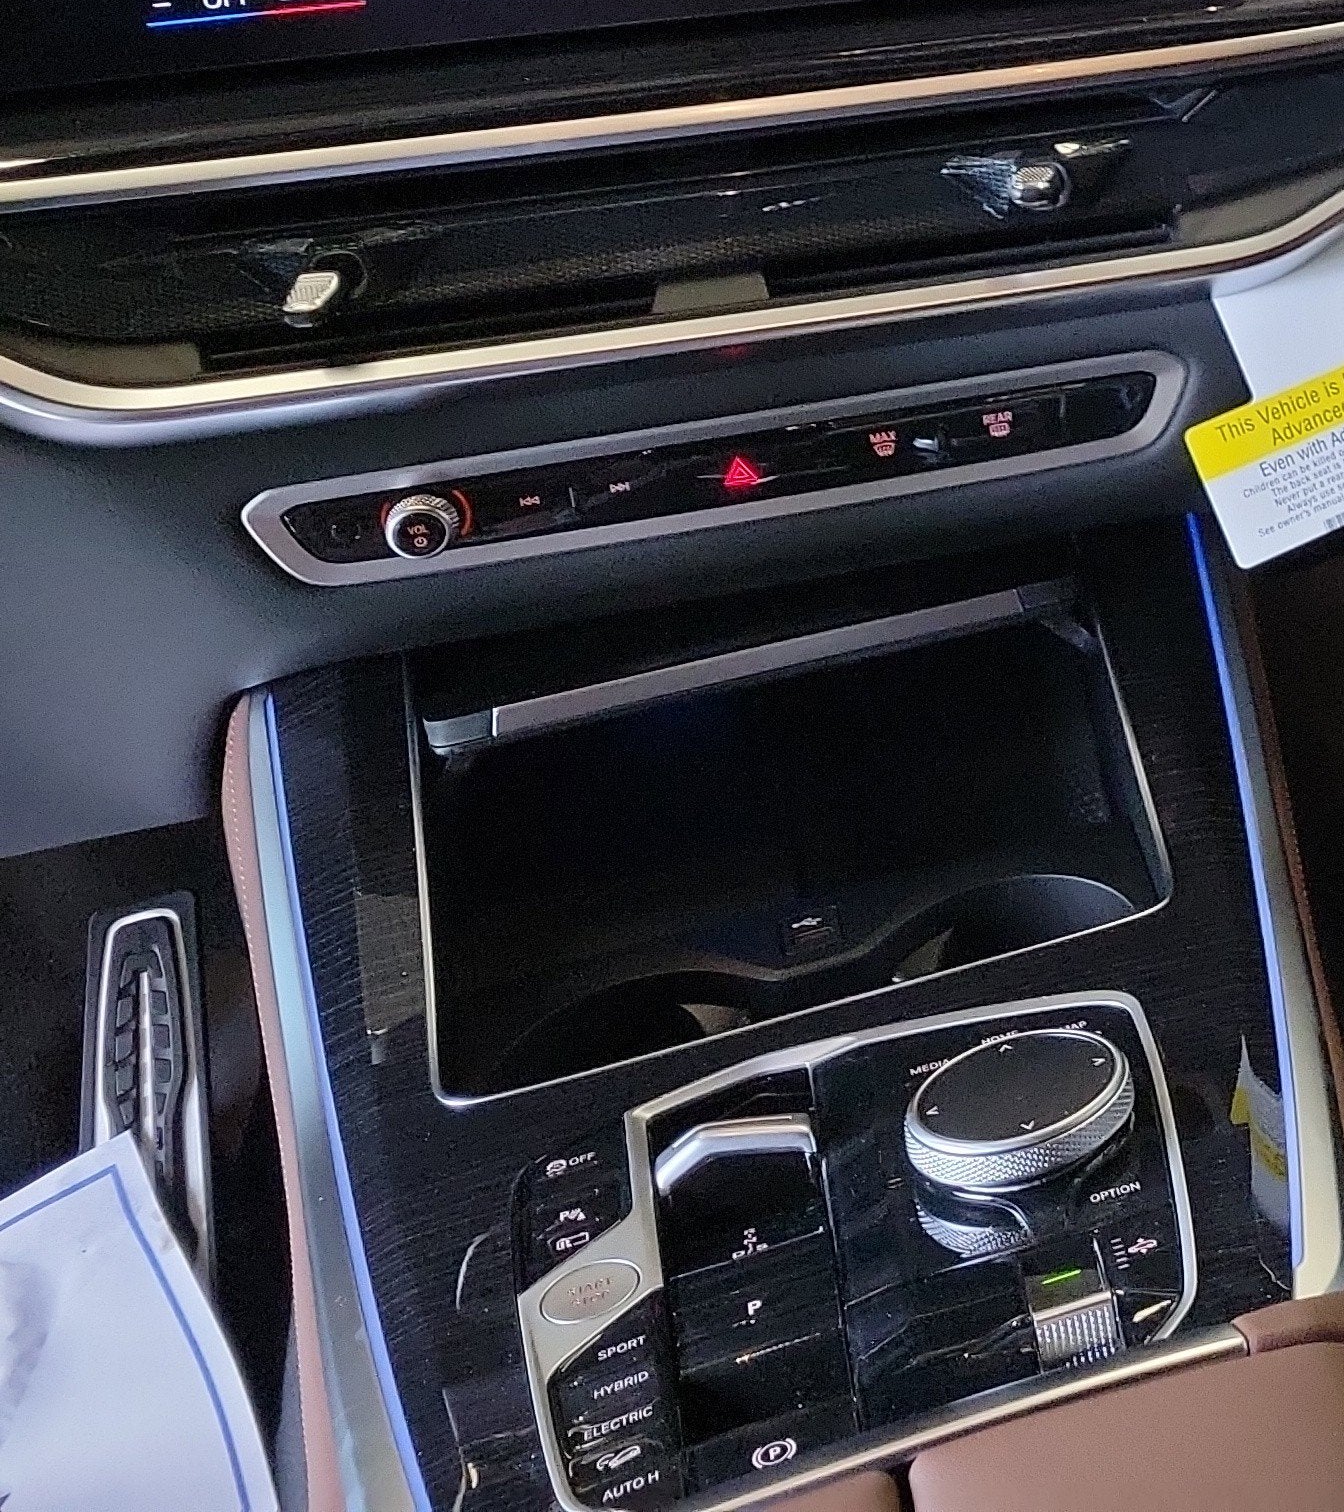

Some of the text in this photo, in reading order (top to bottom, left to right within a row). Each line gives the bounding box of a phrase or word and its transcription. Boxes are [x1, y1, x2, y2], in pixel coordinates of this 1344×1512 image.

[1215, 418, 1256, 442] This
[1256, 390, 1320, 424] Vehicle
[1322, 381, 1340, 398] is
[1259, 454, 1296, 477] Even
[1296, 439, 1328, 461] with
[406, 523, 430, 535] VOL
[568, 1151, 597, 1167] OFF
[1089, 1180, 1142, 1205] OPTION
[747, 1299, 763, 1317] P
[597, 1335, 647, 1362] SPORT
[593, 1370, 650, 1400] HYBRID
[583, 1406, 654, 1441] ELECTRIC
[602, 1470, 660, 1504] AUTO H
